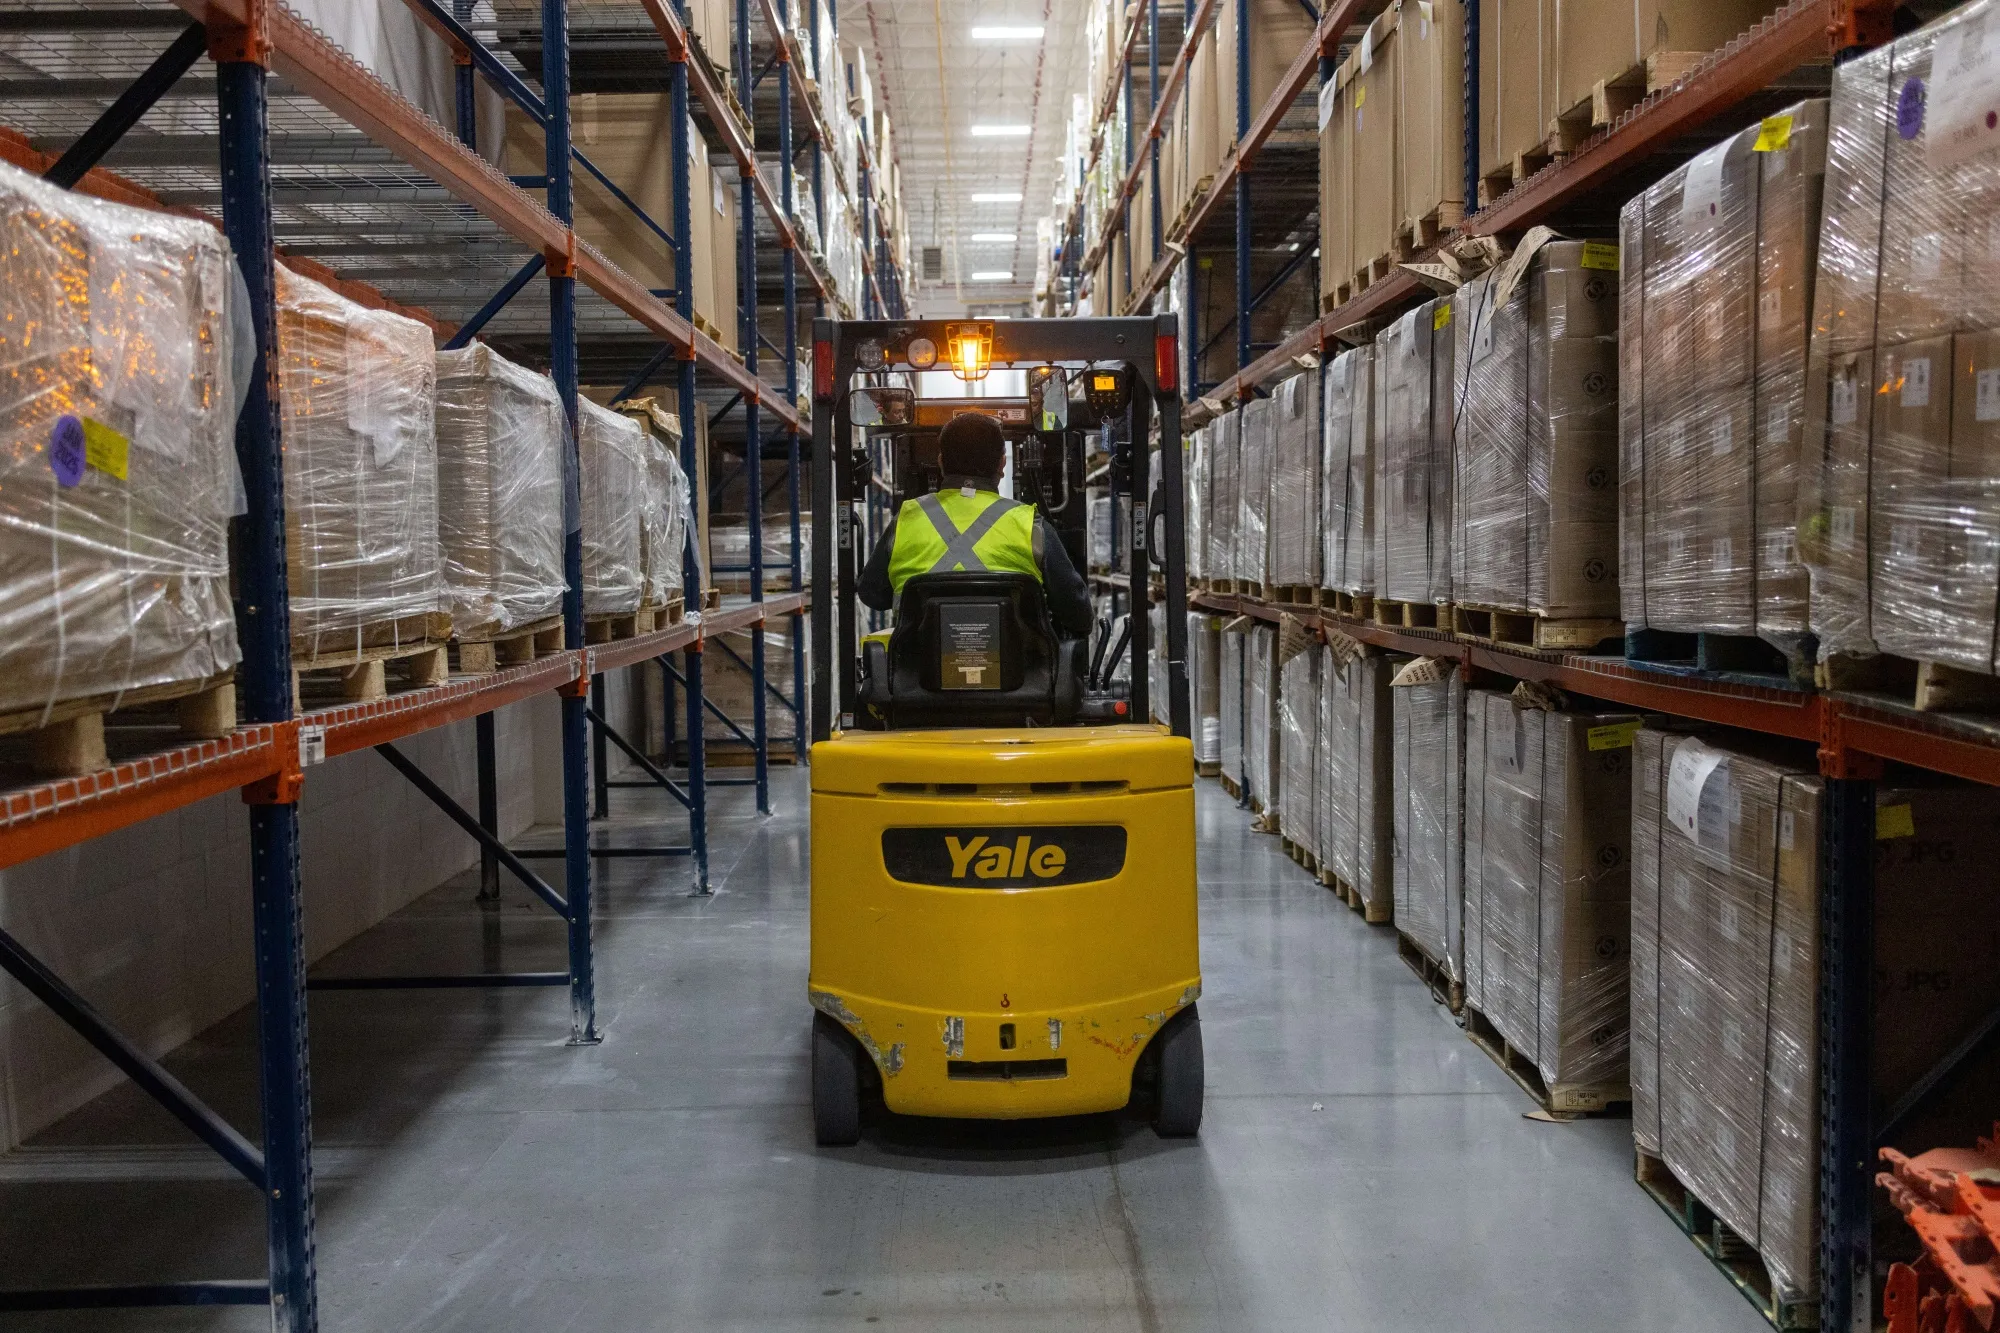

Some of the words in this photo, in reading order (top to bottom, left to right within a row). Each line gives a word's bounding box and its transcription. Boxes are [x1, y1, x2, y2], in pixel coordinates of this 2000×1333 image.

[1419, 664, 1429, 681] STAC
[944, 835, 1066, 878] Yale
[1903, 840, 1955, 863] JPG
[1901, 970, 1951, 991] JPG
